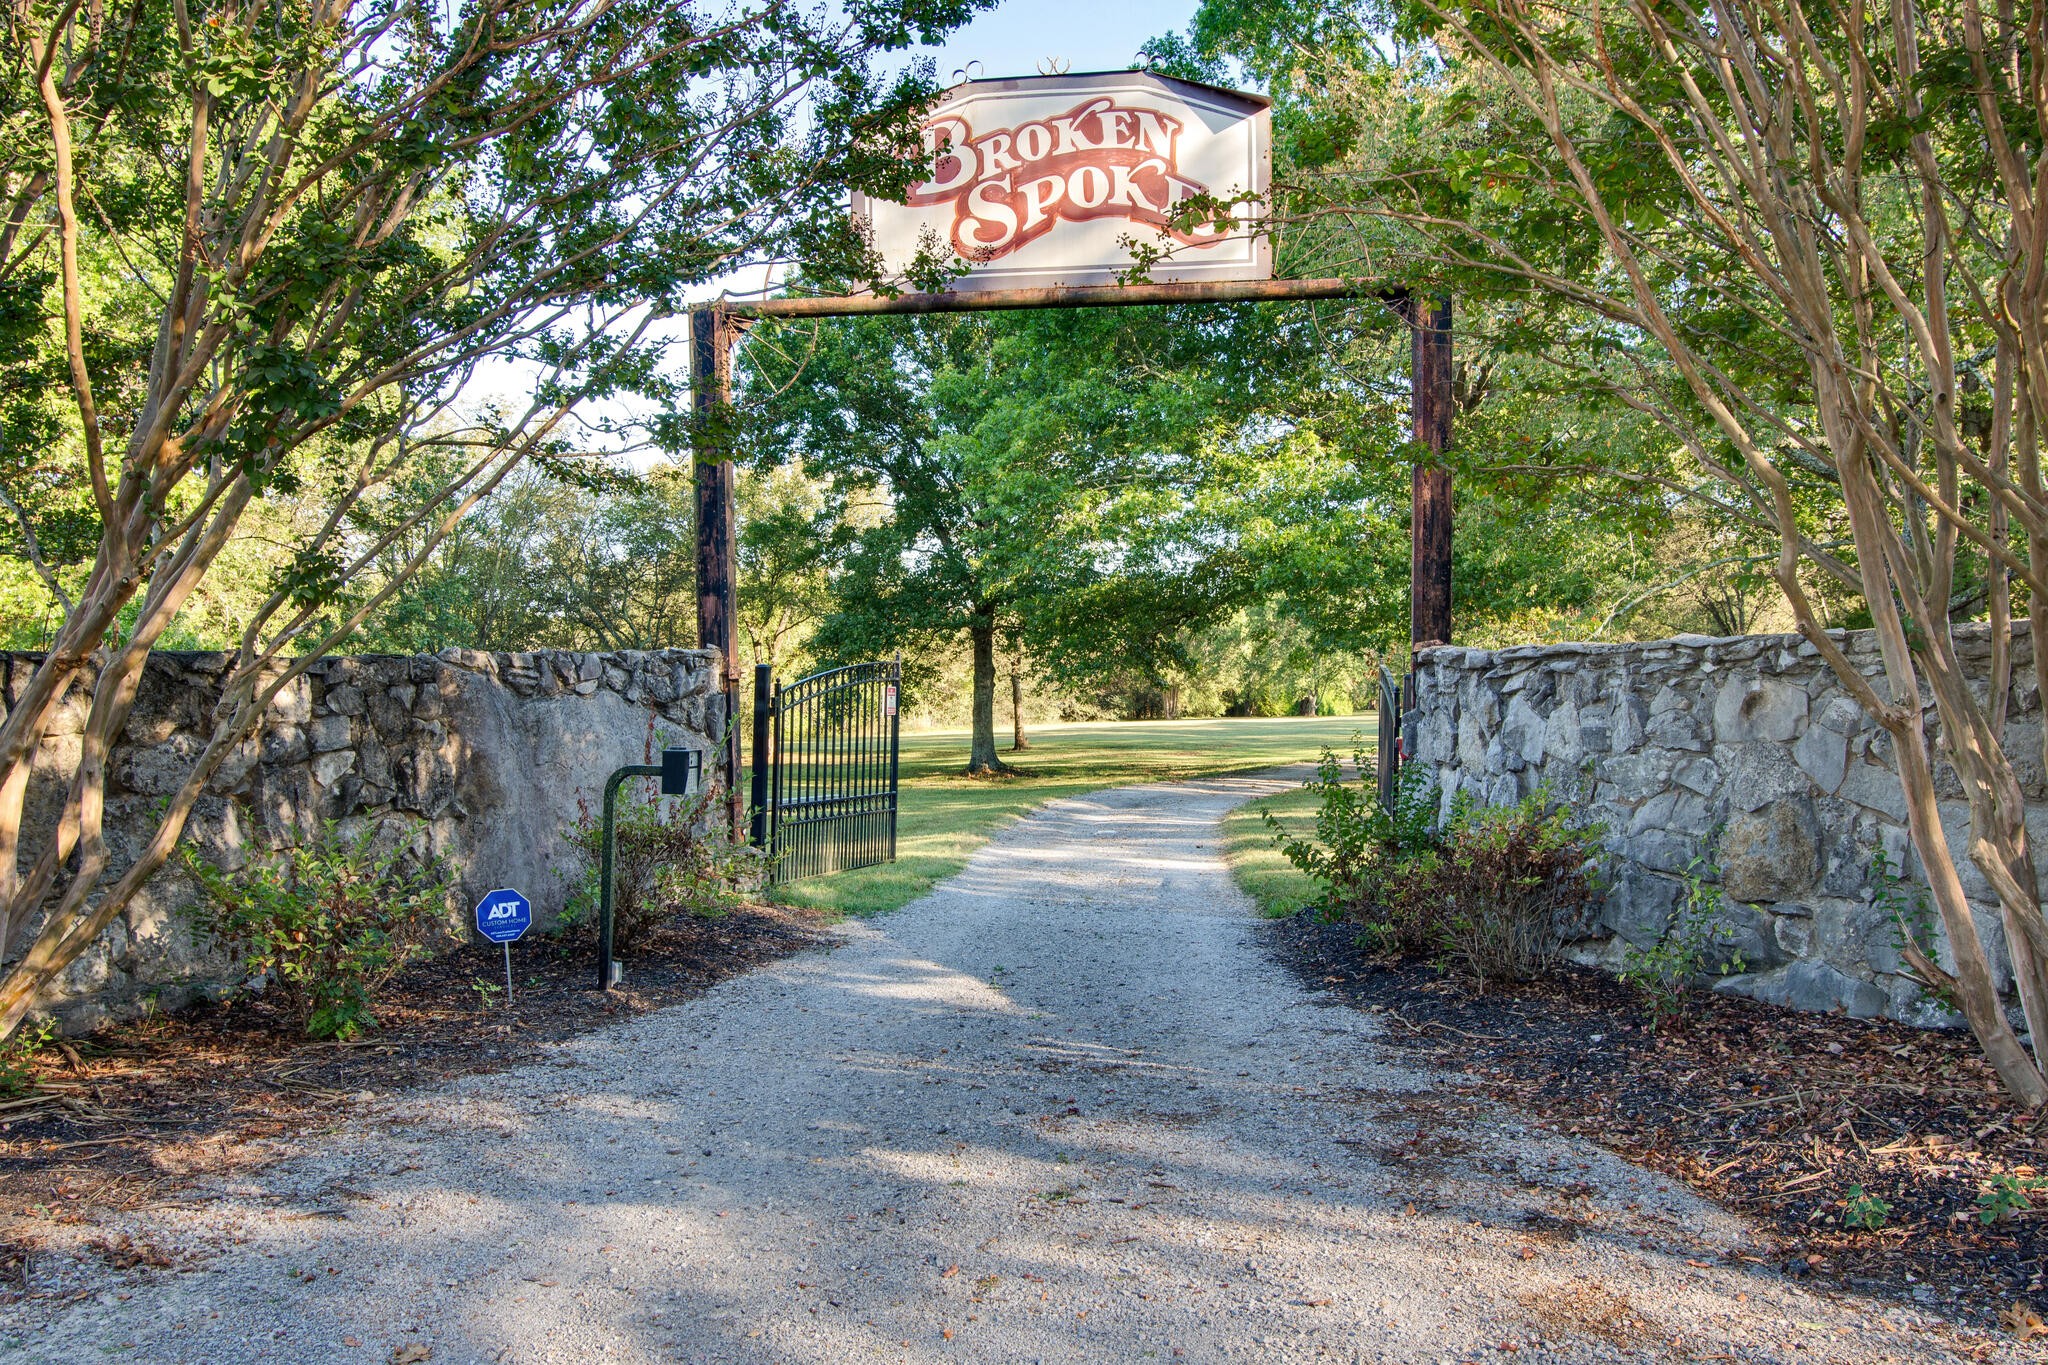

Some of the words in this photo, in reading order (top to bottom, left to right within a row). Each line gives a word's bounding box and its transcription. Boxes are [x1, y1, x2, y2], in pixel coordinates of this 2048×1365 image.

[915, 100, 1180, 196] BROKEN
[487, 901, 520, 920] ADT
[482, 919, 508, 928] CUSTOM
